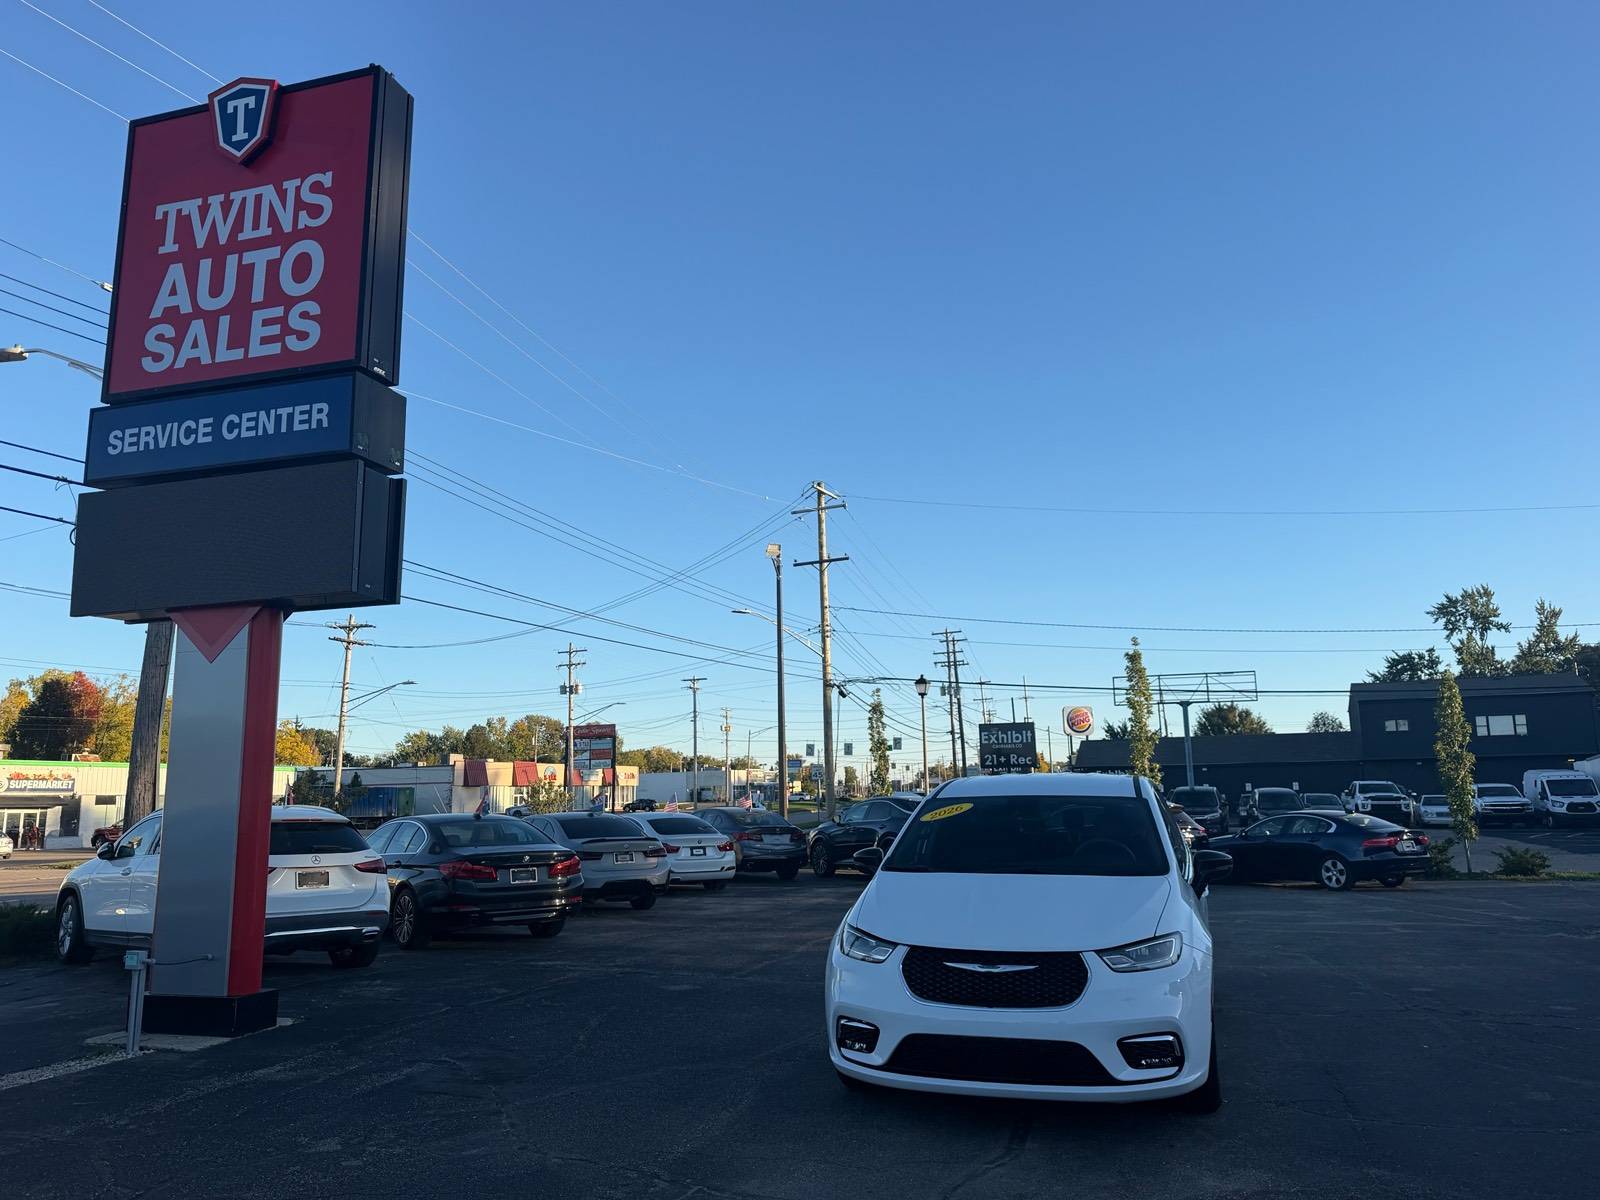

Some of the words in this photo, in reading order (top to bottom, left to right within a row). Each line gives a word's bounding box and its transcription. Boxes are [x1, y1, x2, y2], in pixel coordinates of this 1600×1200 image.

[226, 95, 256, 143] T
[154, 171, 334, 255] TWINS
[149, 239, 325, 319] AUTO
[141, 301, 322, 373] SALES
[106, 416, 213, 456] SERVICE
[221, 402, 330, 441] CENTER
[1071, 717, 1091, 727] KING
[984, 754, 1007, 765] 21+
[1010, 754, 1033, 765] Rec
[9, 779, 74, 789] SUPERMARKET
[812, 771, 823, 779] 45
[929, 806, 963, 818] 2026
